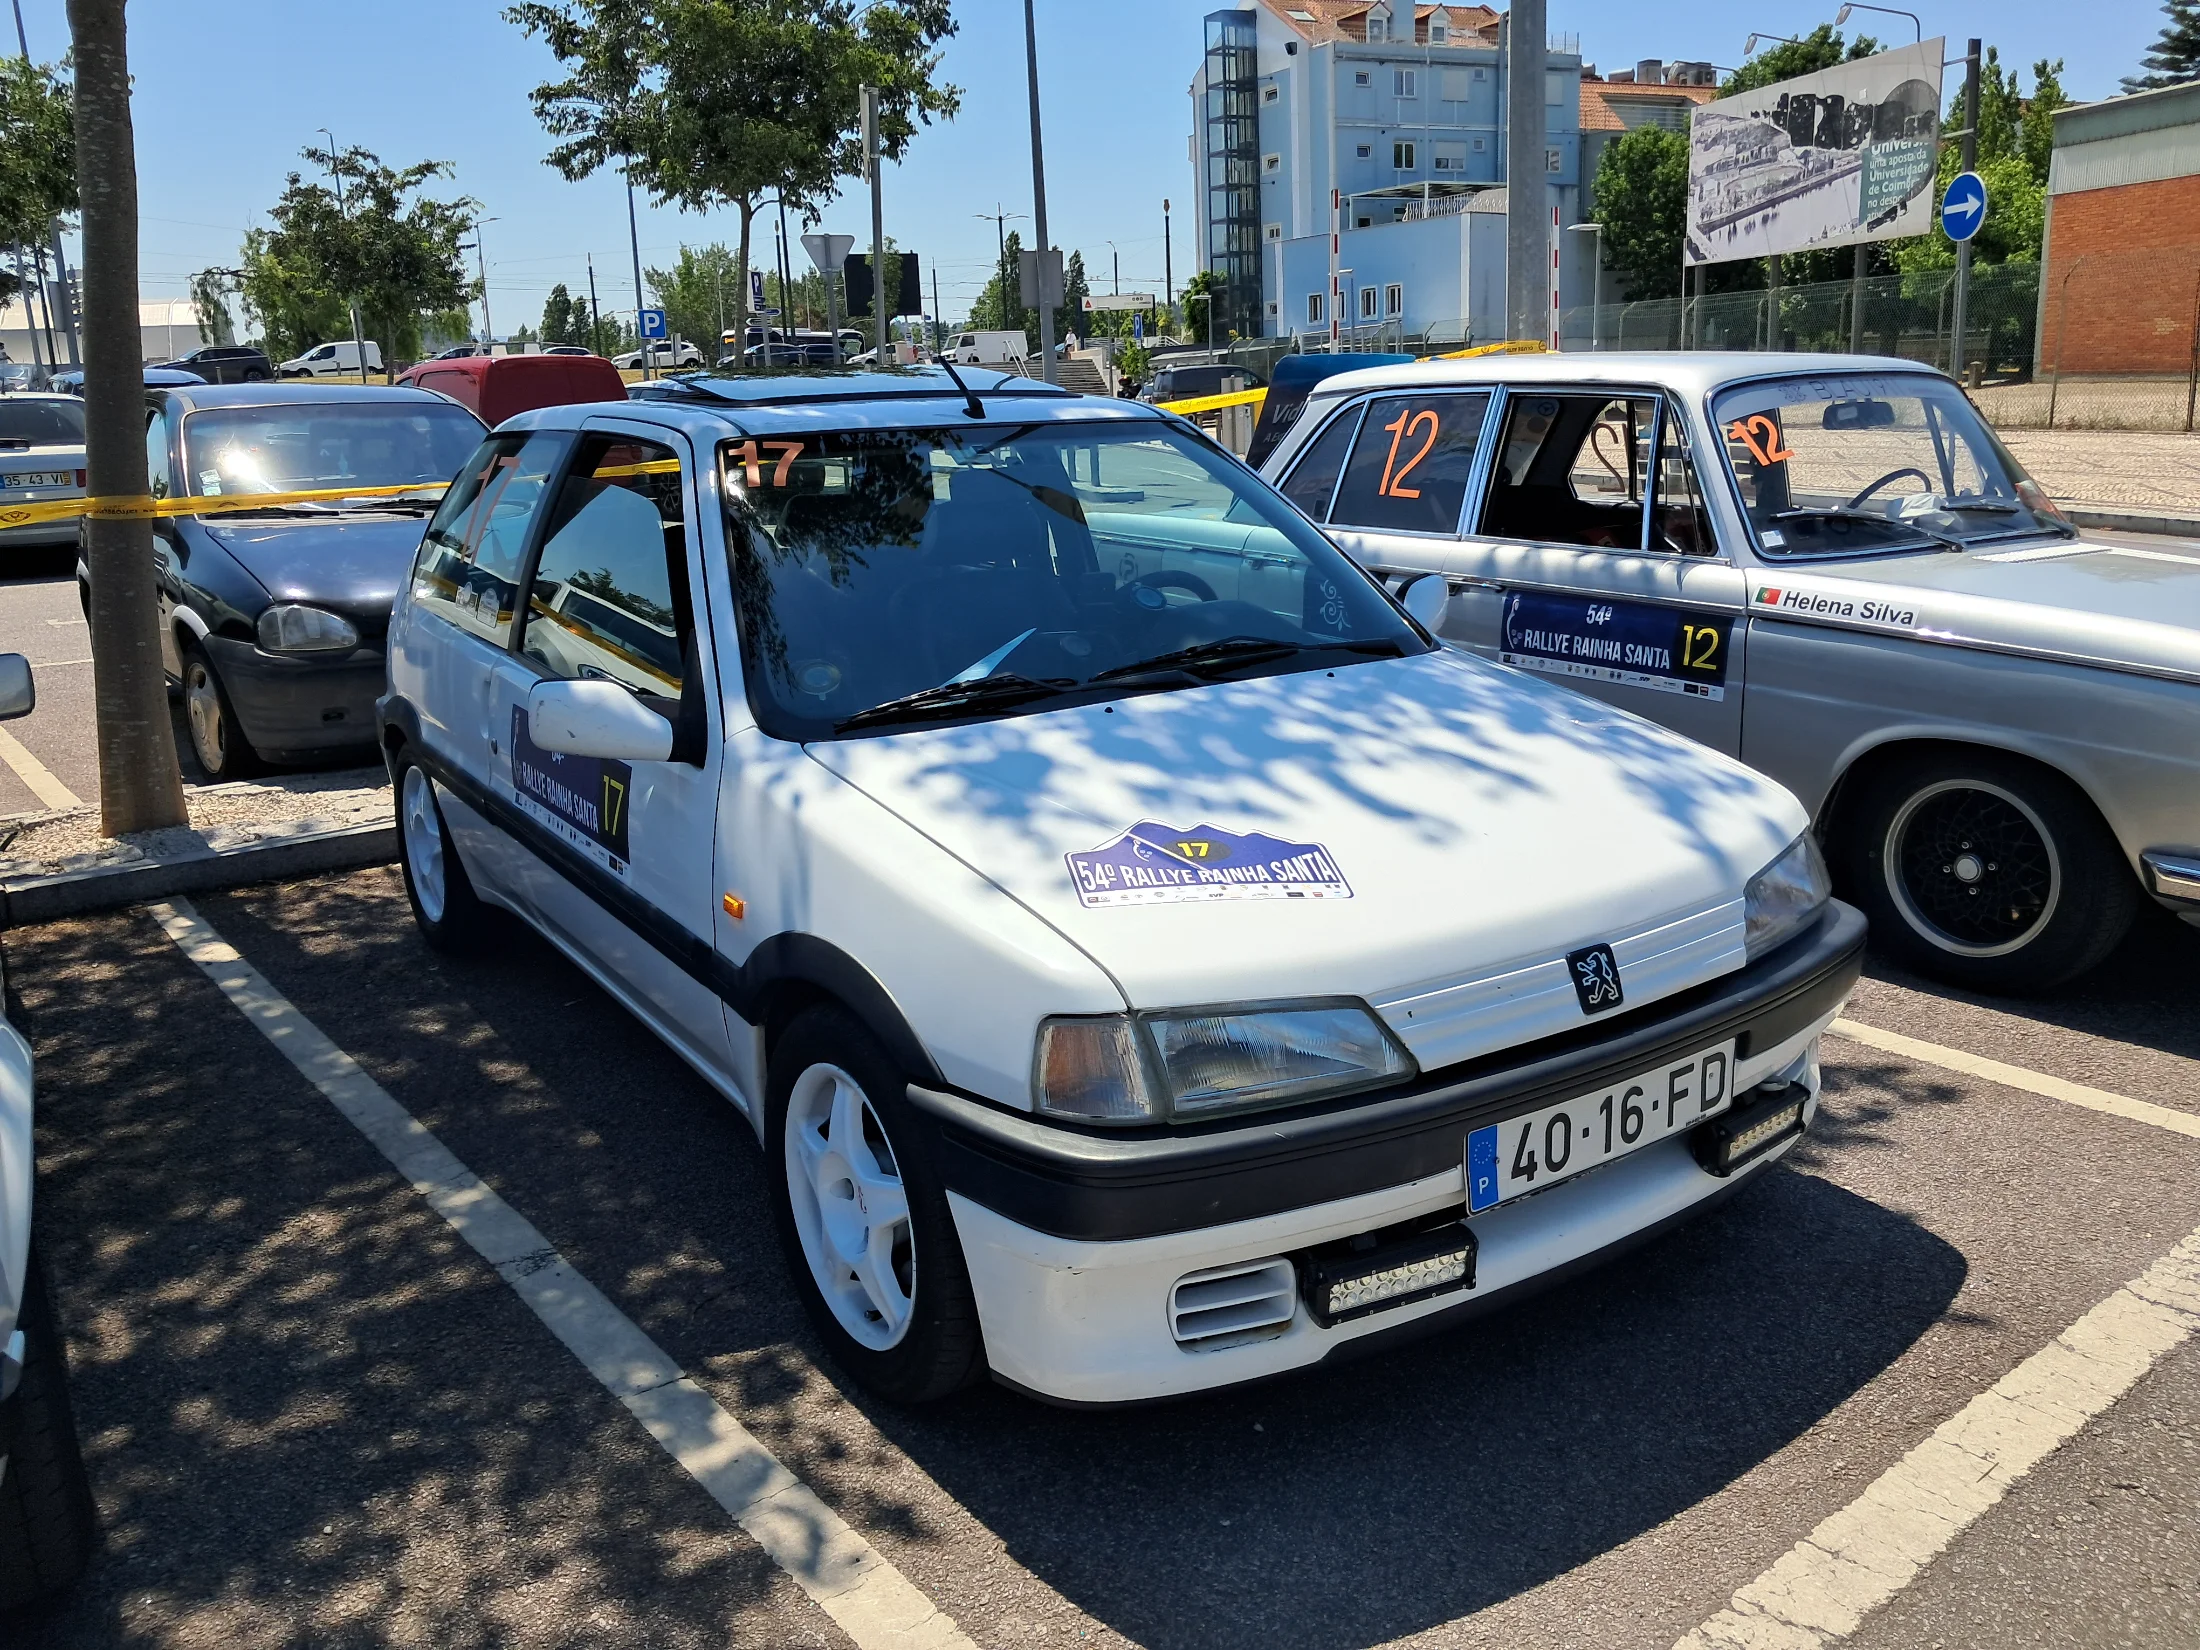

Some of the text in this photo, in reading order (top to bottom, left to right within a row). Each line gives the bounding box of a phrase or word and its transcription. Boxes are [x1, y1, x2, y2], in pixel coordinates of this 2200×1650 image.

[1869, 148, 1926, 170] uma aposta da
[1869, 161, 1929, 182] Universidade
[1867, 200, 1878, 208] no
[1868, 177, 1920, 196] de Coimbr
[643, 312, 660, 336] P
[1378, 409, 1439, 498] 12
[1728, 415, 1795, 466] 12
[728, 440, 804, 488] 17
[460, 453, 522, 567] 17
[1783, 590, 1914, 625] Helena Silva
[1524, 629, 1670, 669] RALLYE RAINHA SANTA
[1683, 624, 1719, 671] 12
[522, 761, 599, 834] RALLYE RAINHA SANTA
[603, 775, 624, 836] 17
[1177, 842, 1209, 857] 17
[1119, 865, 1196, 887] RALLYE
[1197, 866, 1269, 884] RAINHA
[1270, 851, 1338, 882] SANTA
[1479, 1177, 1489, 1194] P
